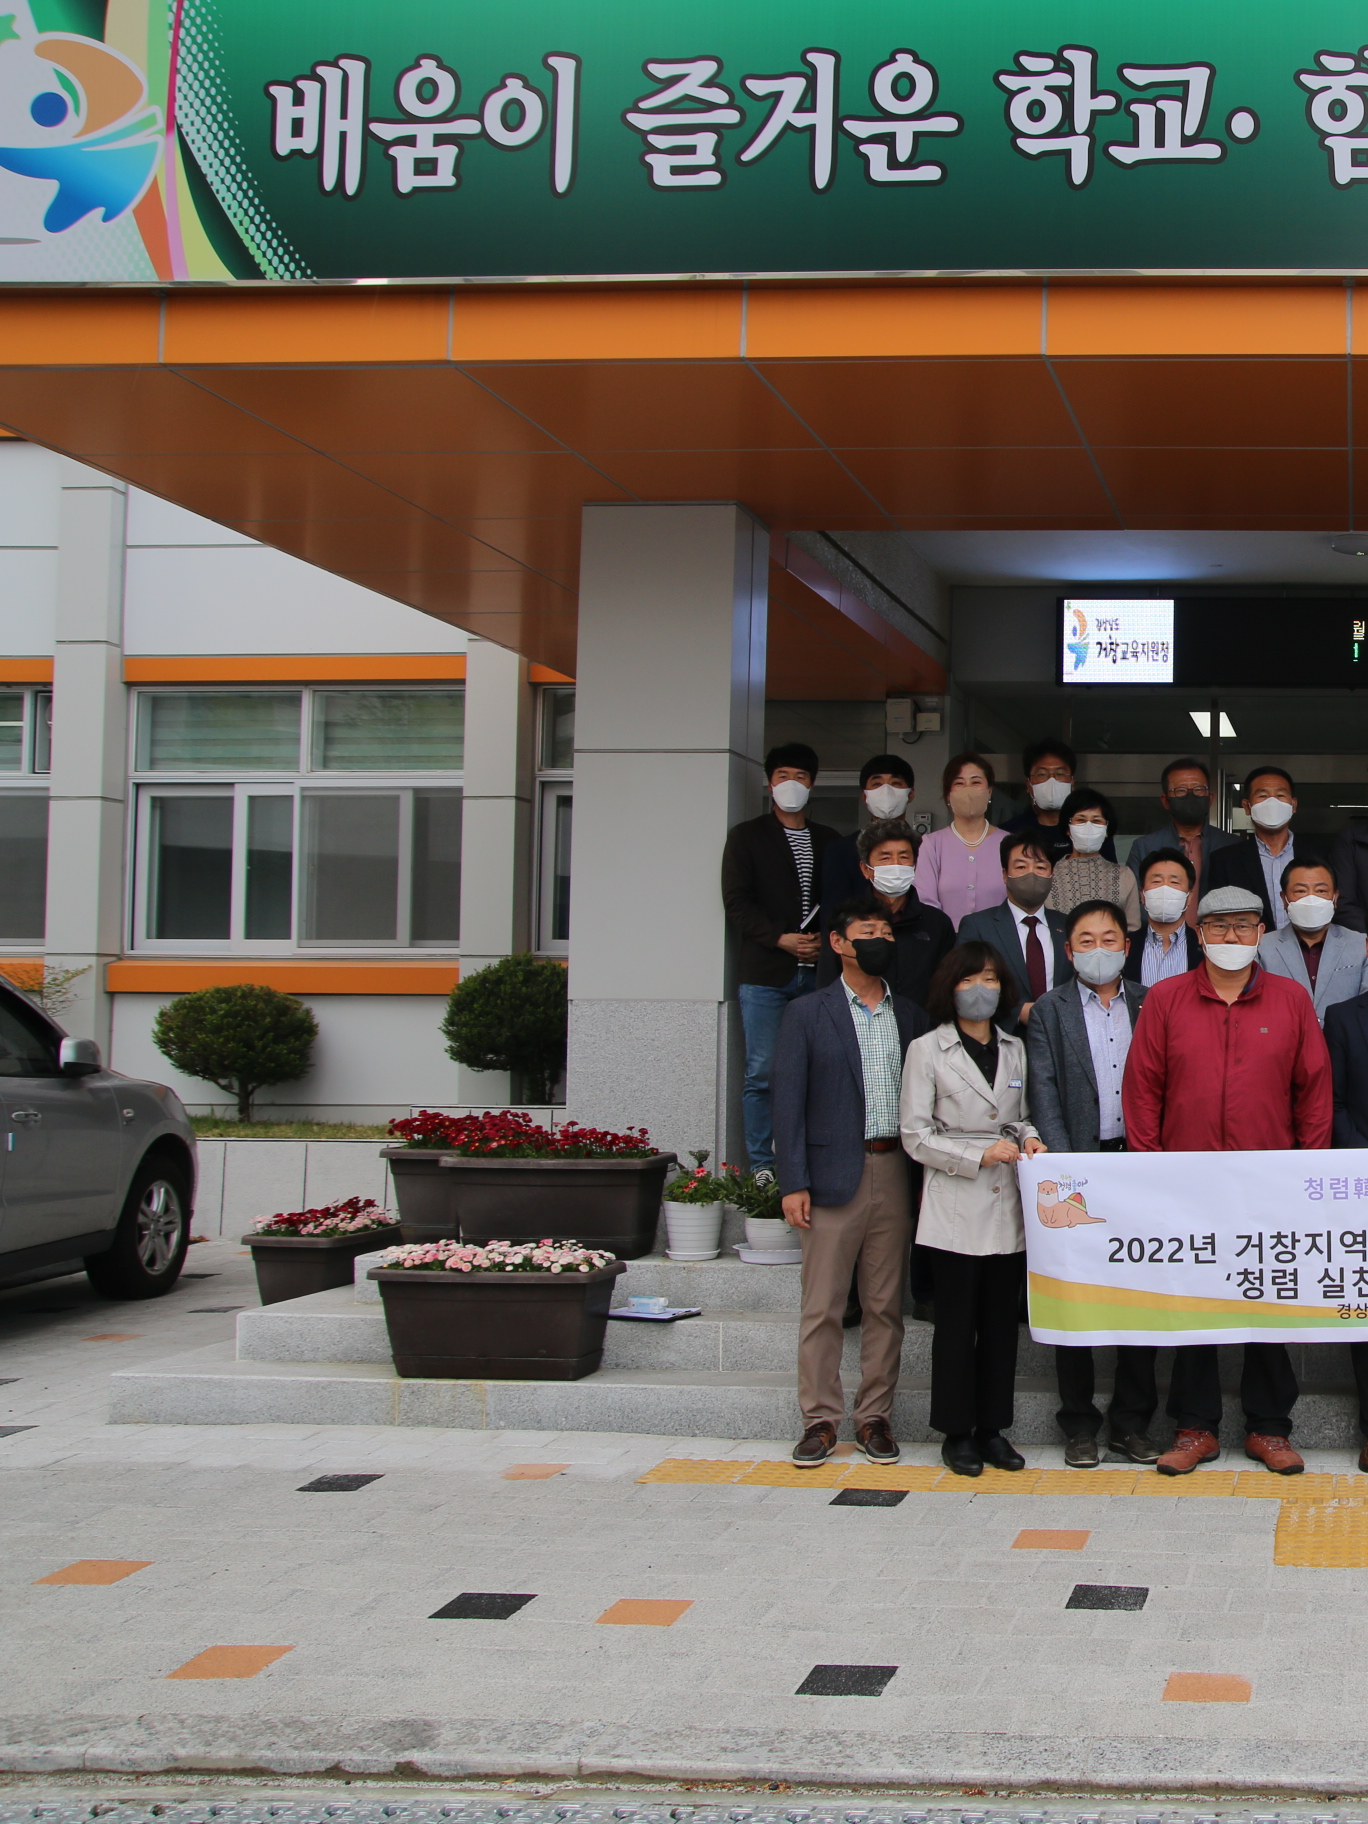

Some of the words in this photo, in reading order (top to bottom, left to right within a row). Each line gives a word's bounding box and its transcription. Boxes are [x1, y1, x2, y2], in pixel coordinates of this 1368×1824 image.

[266, 52, 581, 199] 배움이
[624, 48, 960, 191] 즐거운
[1095, 634, 1170, 665] 거창교육지원청
[1107, 1232, 1217, 1265] 2022년
[1235, 1229, 1368, 1264] 거창지역
